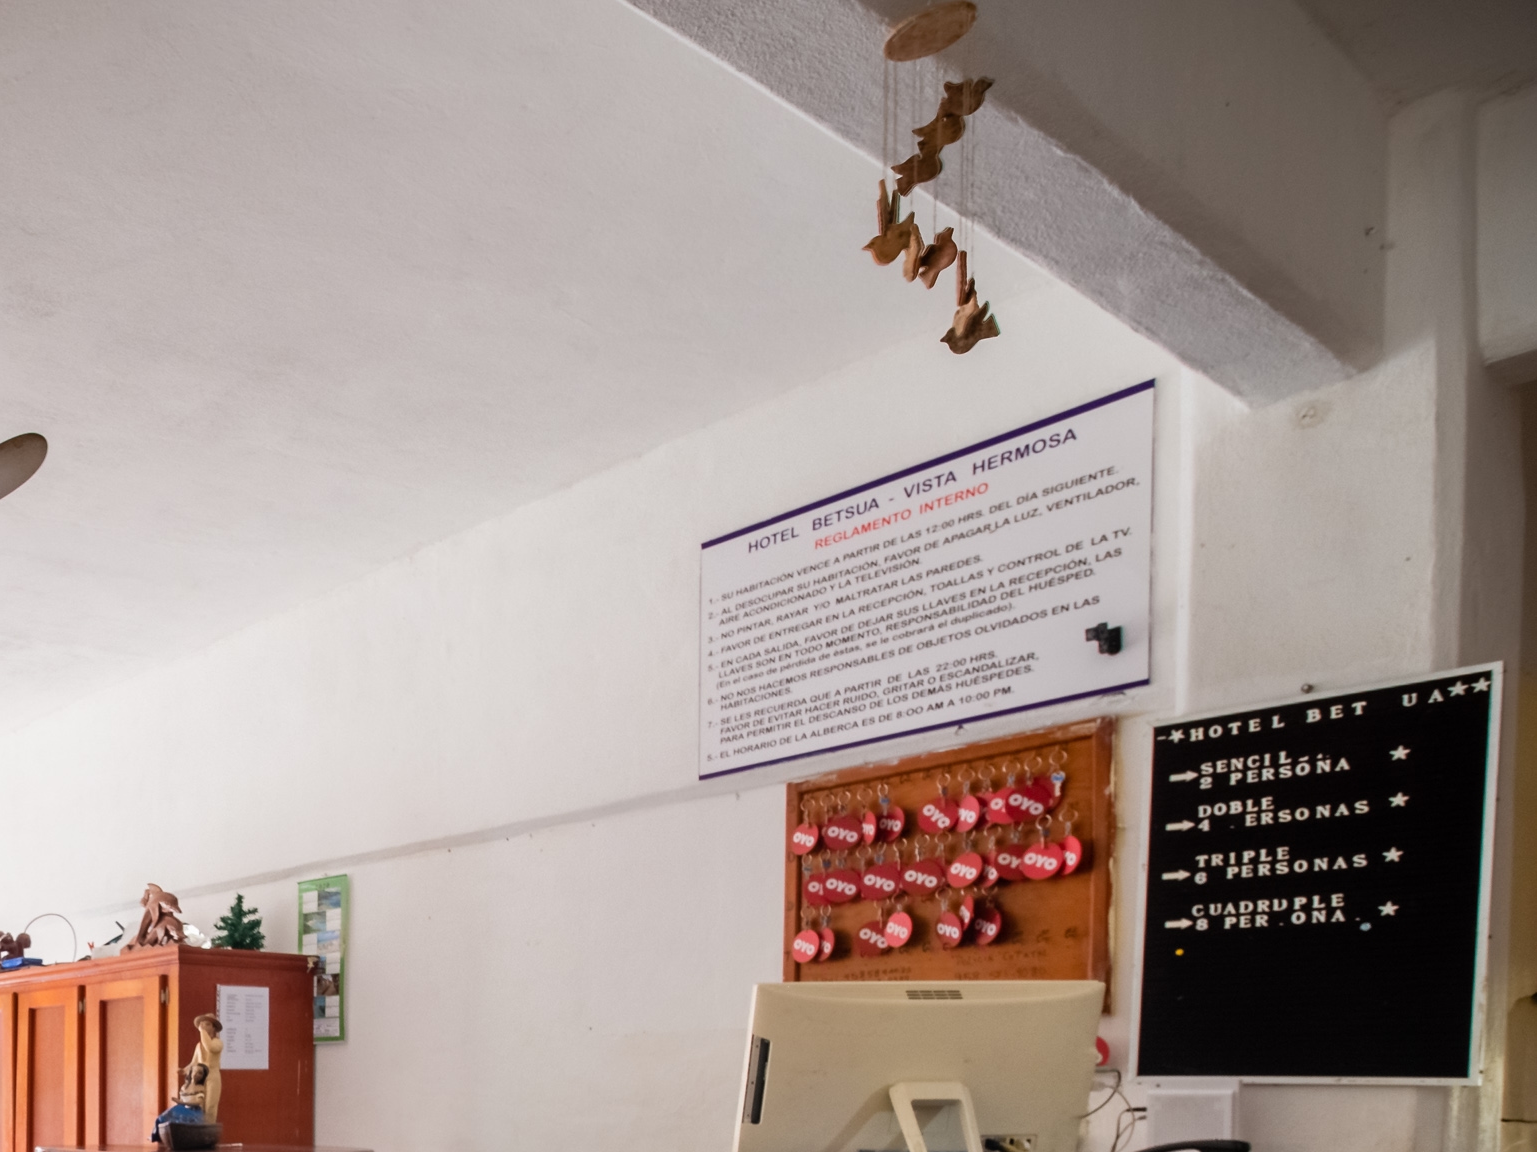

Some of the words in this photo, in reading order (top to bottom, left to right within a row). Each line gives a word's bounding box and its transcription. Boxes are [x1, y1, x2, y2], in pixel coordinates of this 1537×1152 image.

[748, 527, 800, 554] HOTEL
[812, 497, 880, 531] BETSUA
[903, 470, 957, 499] VISTA
[972, 428, 1077, 476] HERMOSA
[814, 508, 912, 550] REGLAMENTO
[919, 482, 989, 515] INTERNO
[721, 591, 734, 601] SU
[796, 559, 830, 576] VENCE
[833, 557, 840, 565] A
[843, 543, 880, 561] PARTIR
[883, 537, 897, 549] DE
[900, 529, 922, 543] LAS
[925, 519, 955, 534] 12:00
[988, 501, 1012, 514] DEL
[721, 607, 732, 615] AL
[735, 586, 794, 611] DESOCUPAR
[797, 581, 810, 591] SU
[884, 546, 921, 564] FAVOR
[924, 540, 939, 552] DE
[942, 523, 993, 546] APAGAR
[993, 517, 1011, 531] LA
[719, 614, 739, 626] AIRE
[743, 586, 827, 618] ACONDICIONADO
[838, 579, 852, 589] LA
[720, 630, 735, 639] NO
[776, 607, 809, 623] RAYAR
[813, 600, 831, 611] Y/O
[835, 580, 898, 605] MALTRATAR
[901, 572, 923, 586] LAS
[721, 639, 751, 654] FAVOR
[753, 634, 765, 644] DE
[768, 618, 823, 640] ENTREGAR
[825, 613, 840, 623] EN
[842, 608, 856, 619] LA
[930, 570, 984, 592] TOALLAS
[987, 567, 994, 576] Y
[997, 548, 1061, 573] CONTROL
[1065, 540, 1083, 554] DE
[1090, 534, 1109, 546] LA
[721, 659, 733, 668] EN
[735, 651, 762, 664] CADA
[804, 629, 838, 644] FAVOR
[841, 624, 853, 634] DE
[858, 613, 893, 629] DEJAR
[897, 606, 919, 618] SUS
[922, 592, 966, 611] LLAVES
[970, 586, 986, 598] EN
[990, 581, 1005, 592] LA
[1095, 547, 1123, 563] LAS
[718, 663, 753, 678] LLAVES
[756, 657, 776, 668] SON
[778, 653, 791, 662] EN
[795, 644, 823, 656] TODO
[886, 595, 997, 631] RESPONSABILIDAD
[1000, 588, 1025, 601] DEL
[720, 693, 734, 702] NO
[736, 687, 756, 697] NOS
[759, 673, 808, 691] HACEMOS
[809, 649, 895, 678] RESPONSABLES
[898, 645, 913, 656] DE
[916, 629, 972, 651] OBJETOS
[974, 609, 1048, 636] OLVIDADOS
[1051, 603, 1070, 616] EN
[1073, 595, 1100, 610] LAS
[720, 717, 730, 726] SE
[734, 712, 751, 722] LES
[754, 698, 807, 717] RECUERDA
[809, 691, 831, 703] QUE
[834, 689, 842, 697] A
[844, 678, 882, 694] PARTIR
[887, 673, 902, 684] DE
[908, 667, 930, 679] LAS
[936, 658, 967, 672] 22:00
[720, 722, 750, 735] FAVOR
[753, 719, 763, 727] DE
[768, 709, 802, 723] EVITAR
[805, 700, 840, 714] HACER
[883, 679, 924, 695] GRITAR
[928, 676, 936, 685] O
[719, 751, 730, 759] EL
[733, 739, 777, 755] HORARIO
[779, 736, 792, 746] DE
[794, 733, 808, 742] LA
[809, 721, 859, 738] ALBERCA
[861, 716, 876, 727] ES
[878, 713, 893, 723] DE
[926, 701, 944, 712] AM
[946, 699, 955, 708] A
[959, 691, 990, 704] 10:00
[720, 733, 744, 744] PARA
[746, 721, 791, 738] PERMITIR
[794, 719, 805, 727] EL
[808, 704, 866, 724] DESCANSO
[869, 699, 883, 709] DE
[887, 694, 908, 705] LOS
[1189, 714, 1285, 742] HOTEL
[1199, 776, 1212, 789] 2
[1229, 757, 1350, 785] PERSONA
[1200, 751, 1329, 775] SENCIL
[923, 804, 950, 828] OYO
[1008, 793, 1044, 815] OYO
[1198, 796, 1274, 818] DOBLE
[1198, 819, 1210, 832] 4
[1230, 800, 1370, 828] ERSONAS
[827, 826, 858, 842] OYO
[950, 862, 977, 879] OYO
[1023, 852, 1057, 870] OYO
[1194, 871, 1208, 885] 6
[1226, 854, 1368, 879] PERSONAS
[1195, 847, 1289, 868] TRIPLE
[864, 874, 895, 891] OYO
[905, 870, 937, 888] OYO
[1195, 918, 1209, 931] 8
[793, 939, 815, 955] OYO
